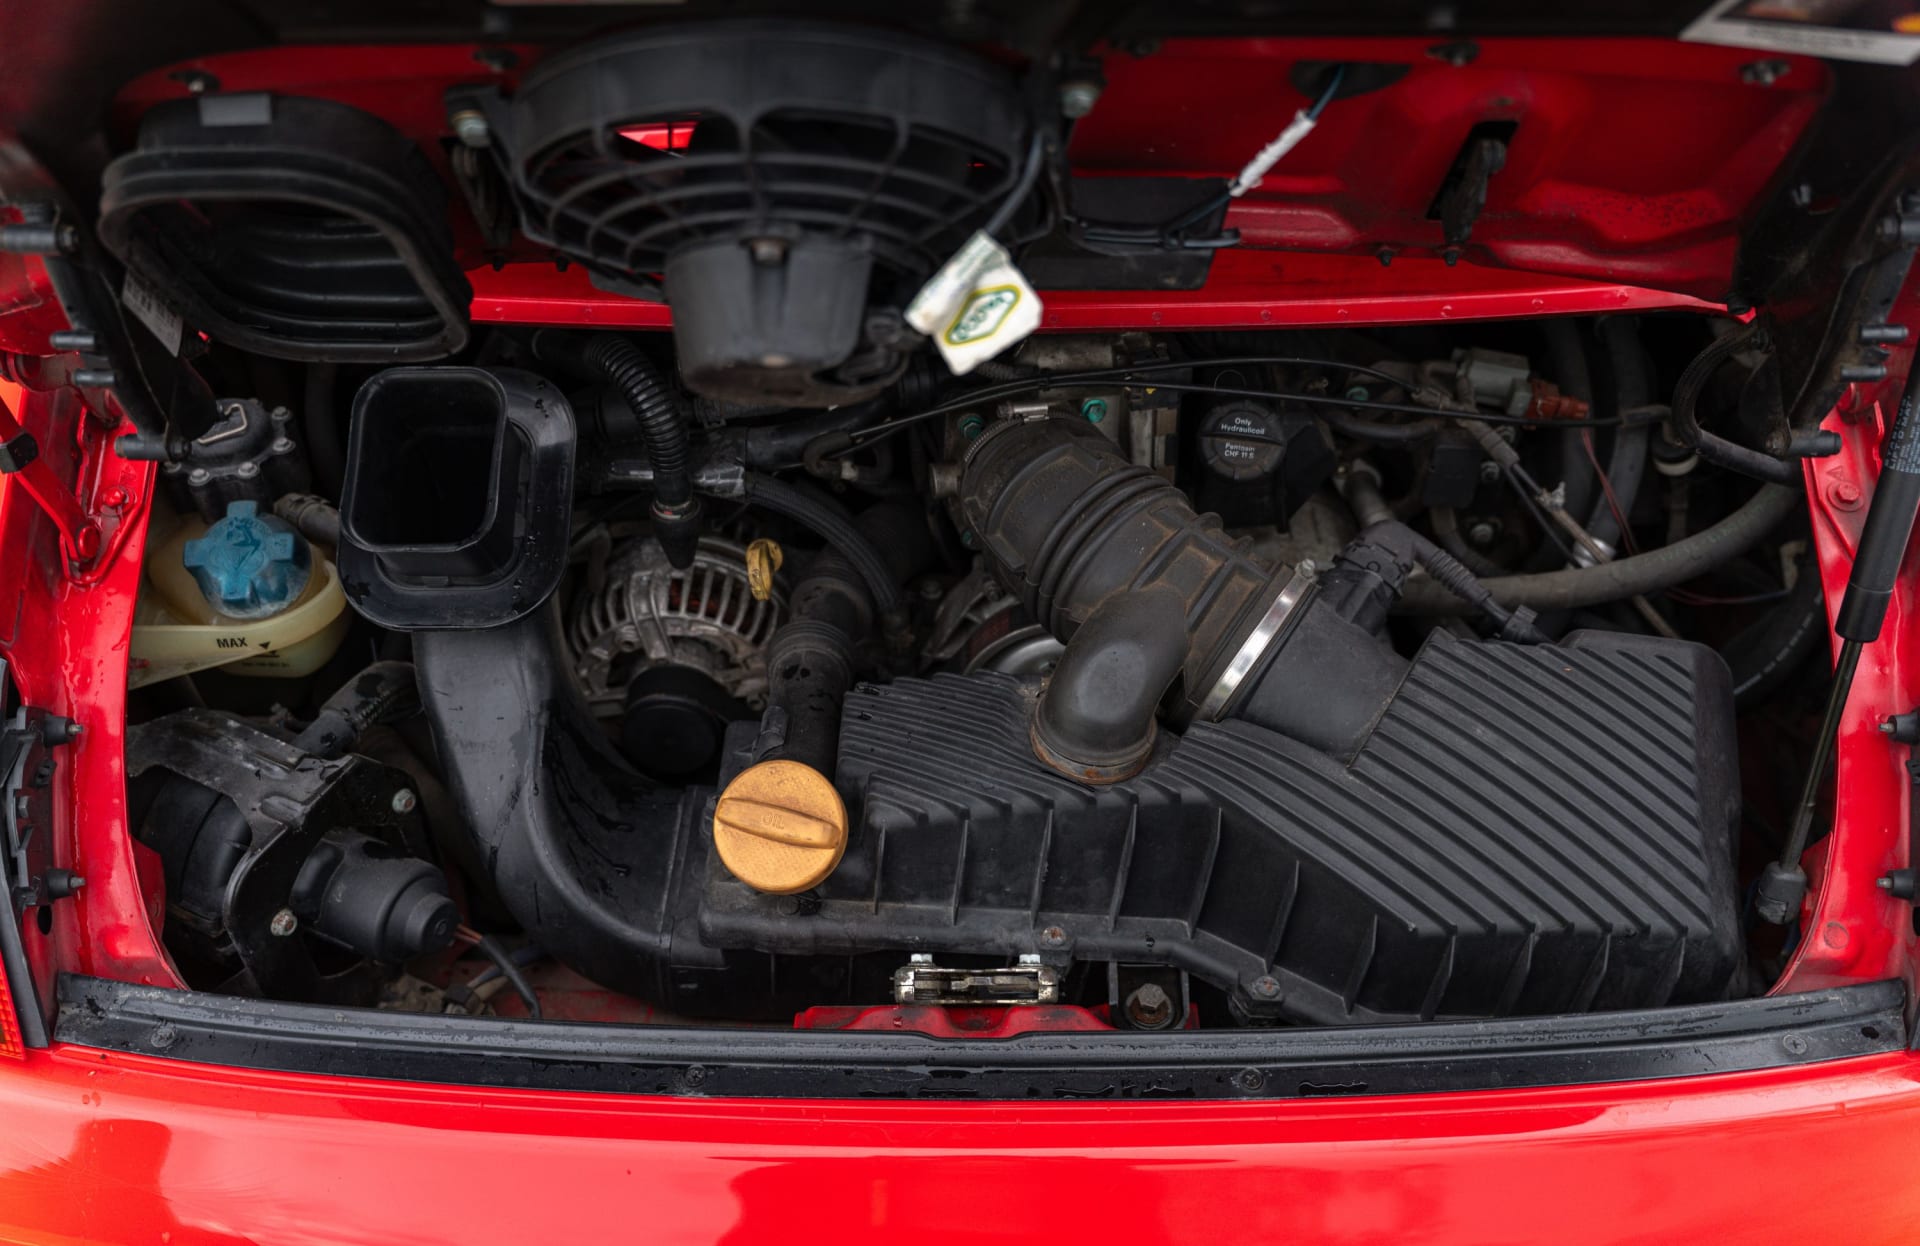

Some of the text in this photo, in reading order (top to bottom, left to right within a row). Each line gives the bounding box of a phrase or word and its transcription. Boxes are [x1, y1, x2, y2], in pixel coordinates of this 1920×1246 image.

[1234, 417, 1252, 427] Only
[1220, 423, 1266, 435] Hydraulicoil
[216, 636, 249, 649] MAX
[761, 812, 785, 830] OIL
